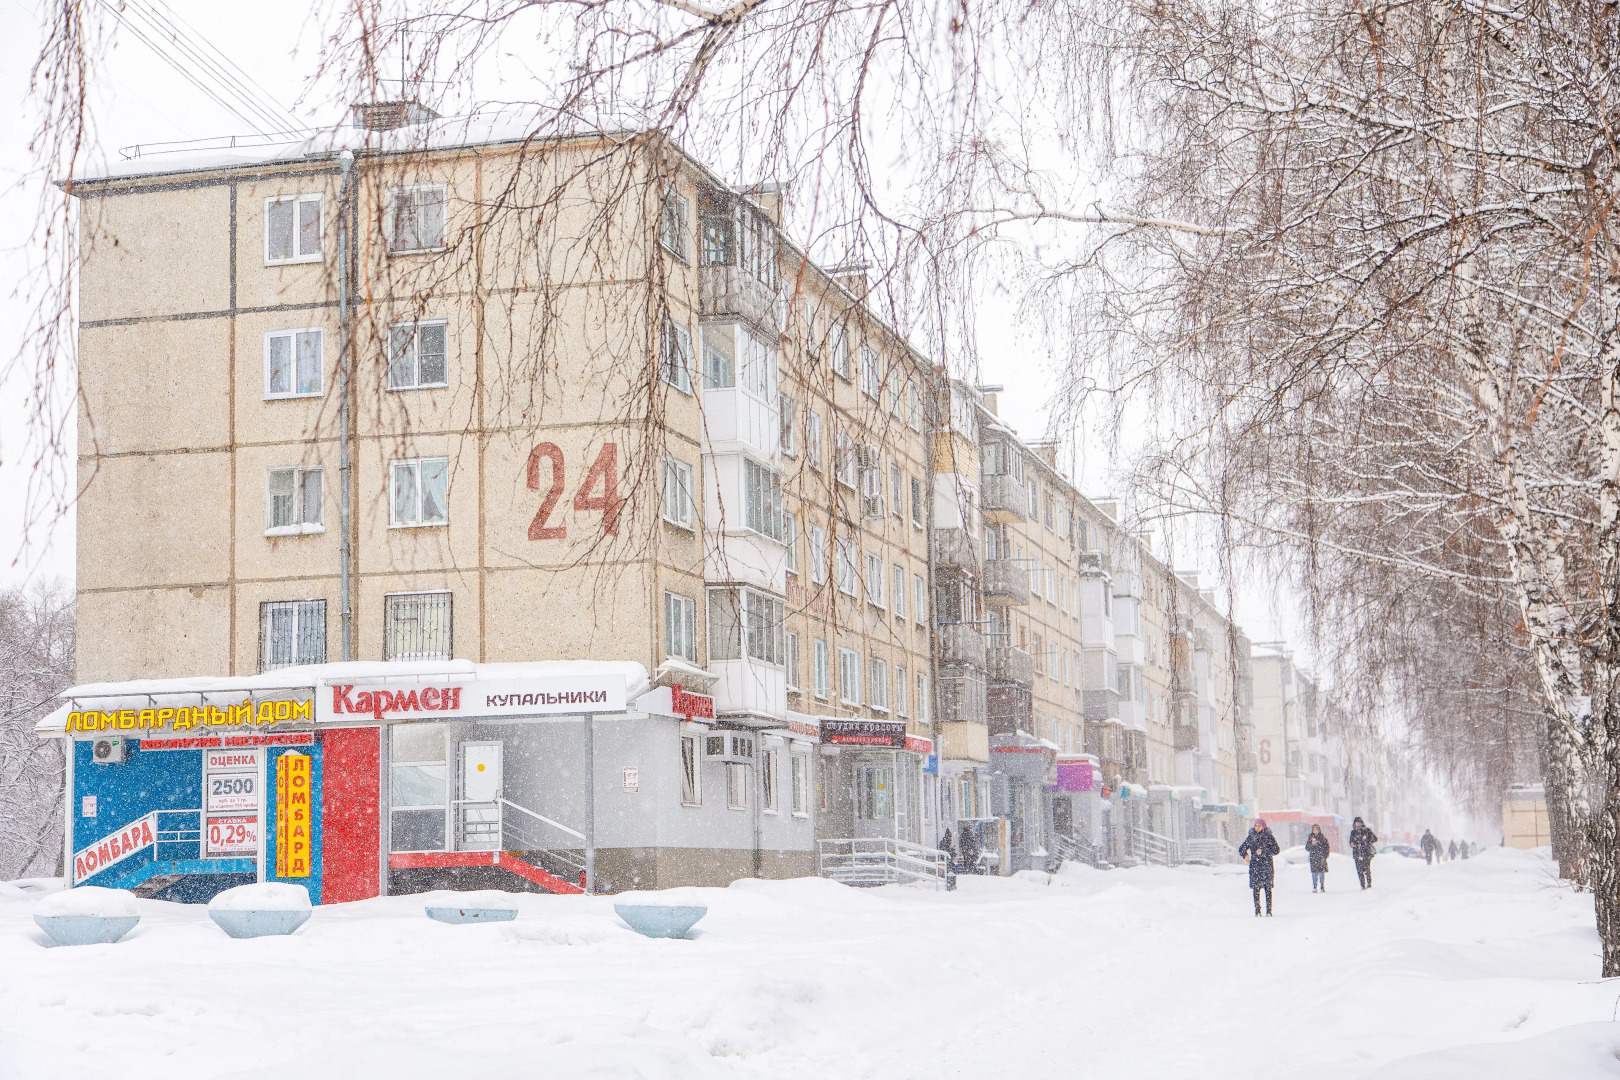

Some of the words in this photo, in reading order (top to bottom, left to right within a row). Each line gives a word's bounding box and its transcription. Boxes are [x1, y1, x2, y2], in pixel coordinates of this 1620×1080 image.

[526, 441, 622, 541] 24
[332, 684, 463, 720] Кармен
[486, 690, 607, 707] КУПАЛЬНИКИ
[65, 698, 254, 733] ЛОМБАРДНЫЙ
[256, 698, 312, 727] ДОМ
[210, 755, 256, 767] ОЦЕНКА
[1260, 739, 1271, 765] 6
[212, 778, 254, 796] 2500
[292, 759, 306, 873] ЛОМБАРД
[76, 821, 154, 879] ЛОМБАРД
[210, 825, 257, 846] 0,29%
